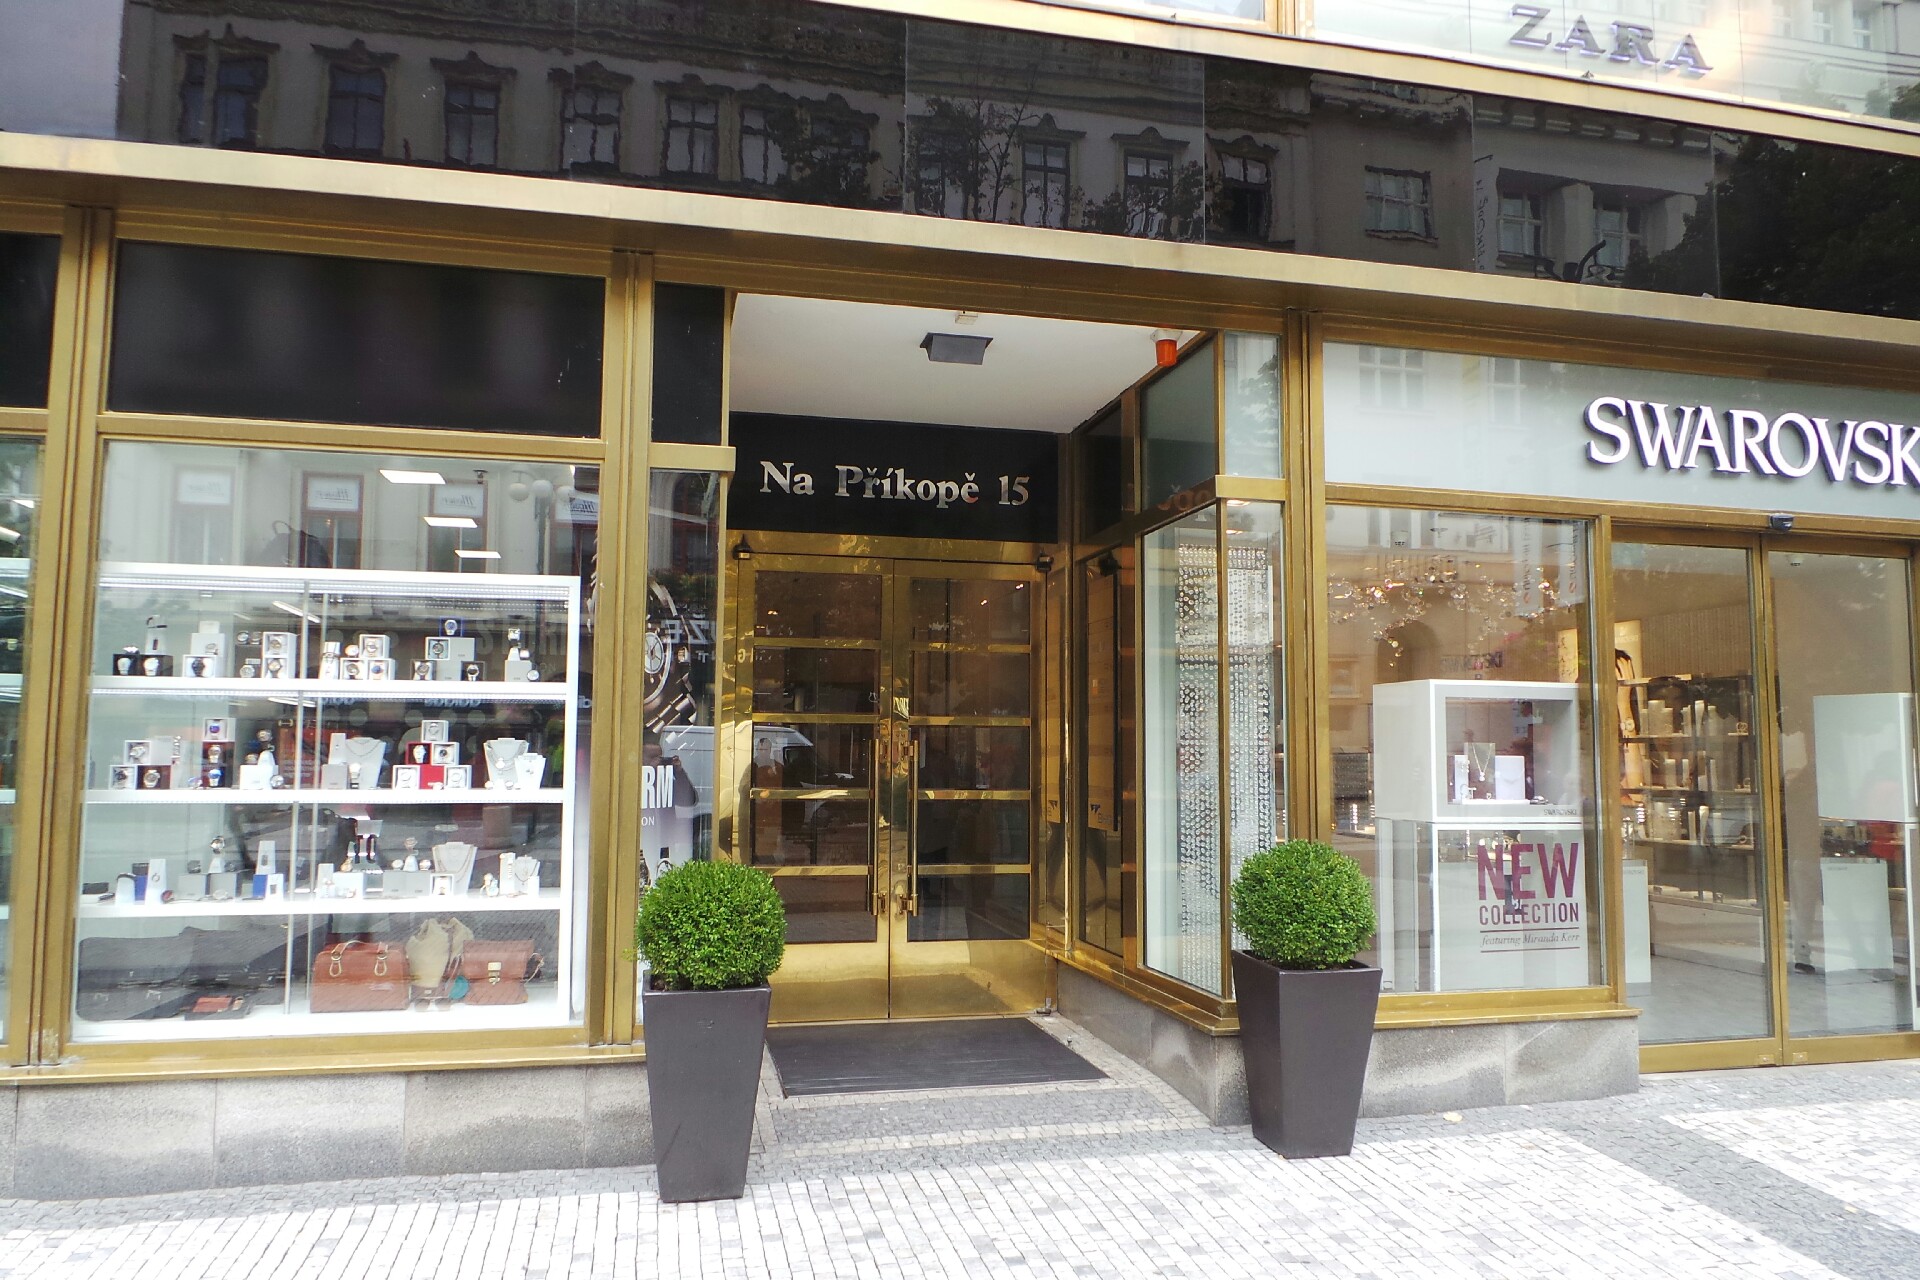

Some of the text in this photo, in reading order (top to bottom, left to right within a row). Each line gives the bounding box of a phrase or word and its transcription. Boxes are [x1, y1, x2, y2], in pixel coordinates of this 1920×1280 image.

[1509, 4, 1713, 75] ZARA
[759, 460, 1030, 509] Na Příkopě 15
[1477, 842, 1579, 901] NEW
[1479, 902, 1580, 926] COLLECTION
[1481, 931, 1581, 947] featuring Miranda Kerr
